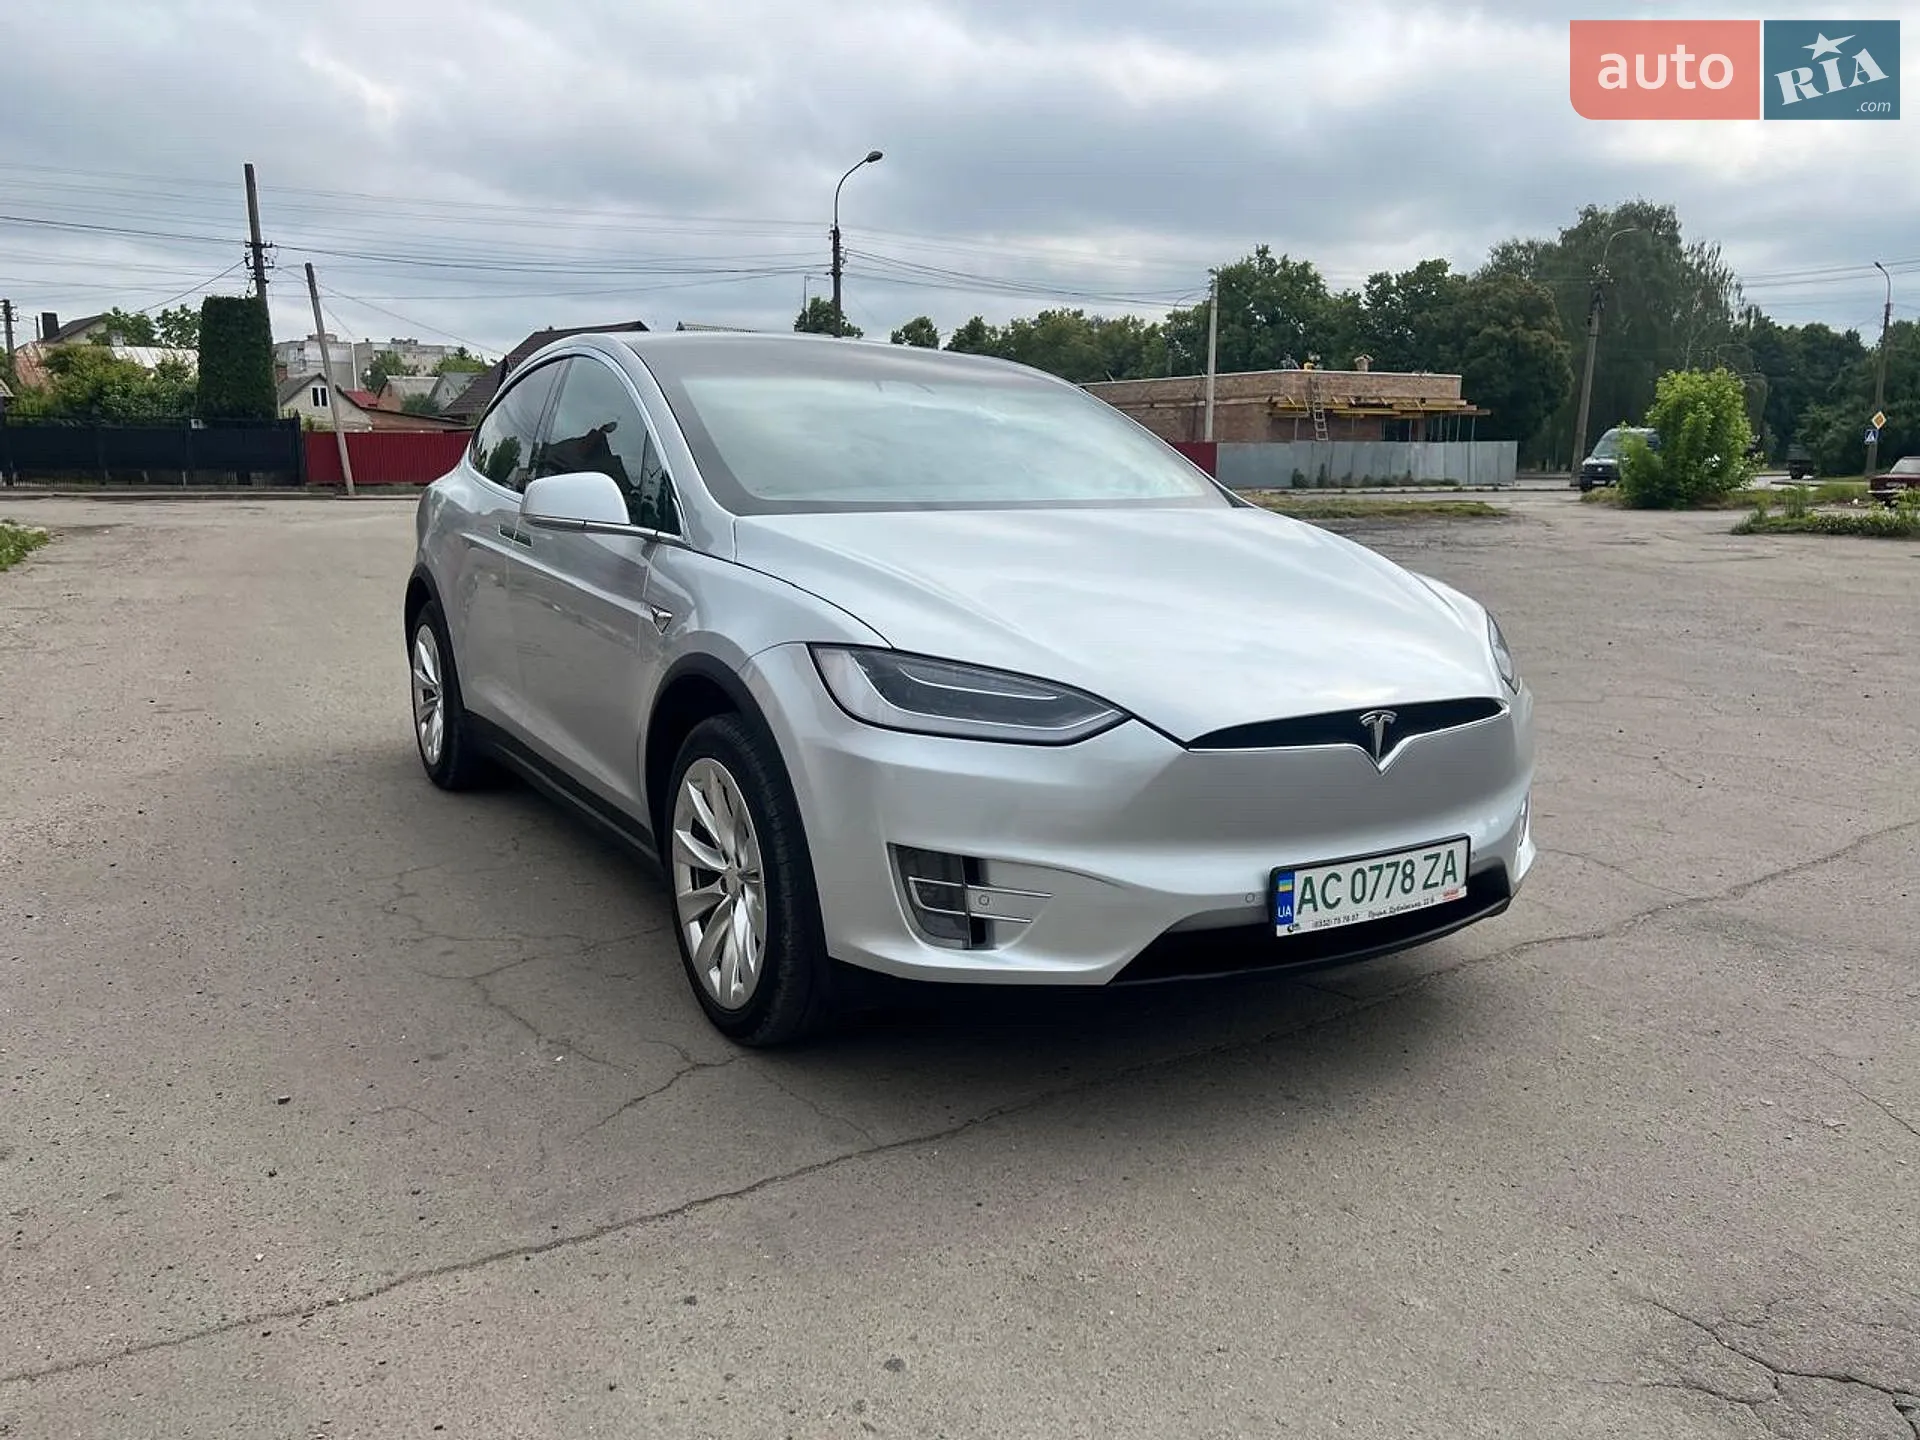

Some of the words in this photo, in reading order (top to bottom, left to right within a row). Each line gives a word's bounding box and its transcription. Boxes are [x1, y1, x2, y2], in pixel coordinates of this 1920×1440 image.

[1296, 871, 1342, 916] AC
[1350, 858, 1416, 905] 0778
[1422, 849, 1458, 891] ZA
[1278, 904, 1292, 919] UA
